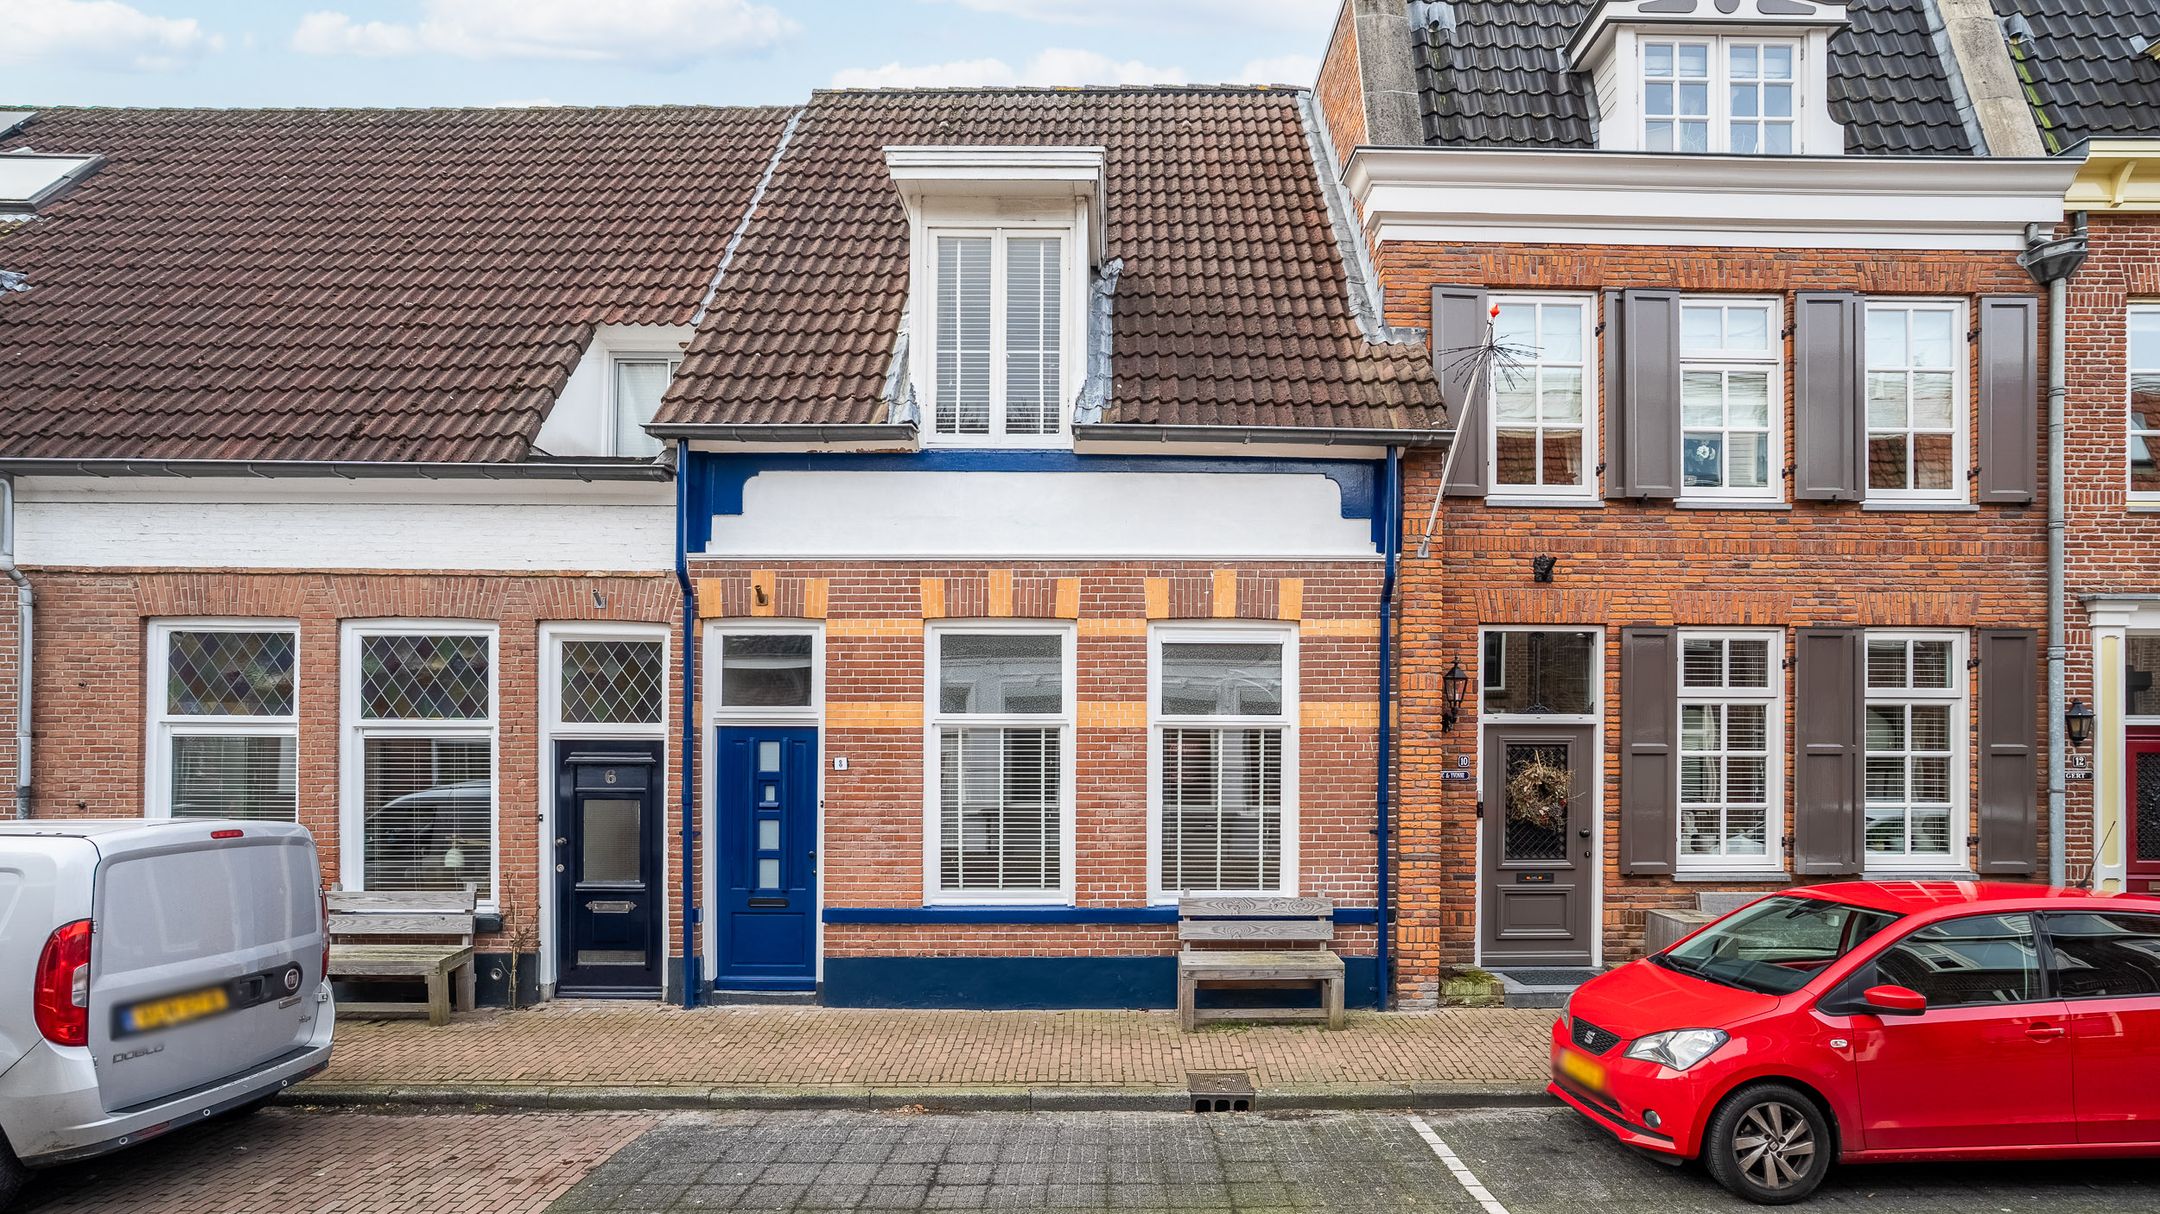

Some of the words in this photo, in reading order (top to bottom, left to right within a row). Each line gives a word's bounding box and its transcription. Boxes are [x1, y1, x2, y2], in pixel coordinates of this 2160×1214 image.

[1460, 757, 1467, 765] 10
[2075, 757, 2084, 765] 12
[605, 769, 616, 784] 6
